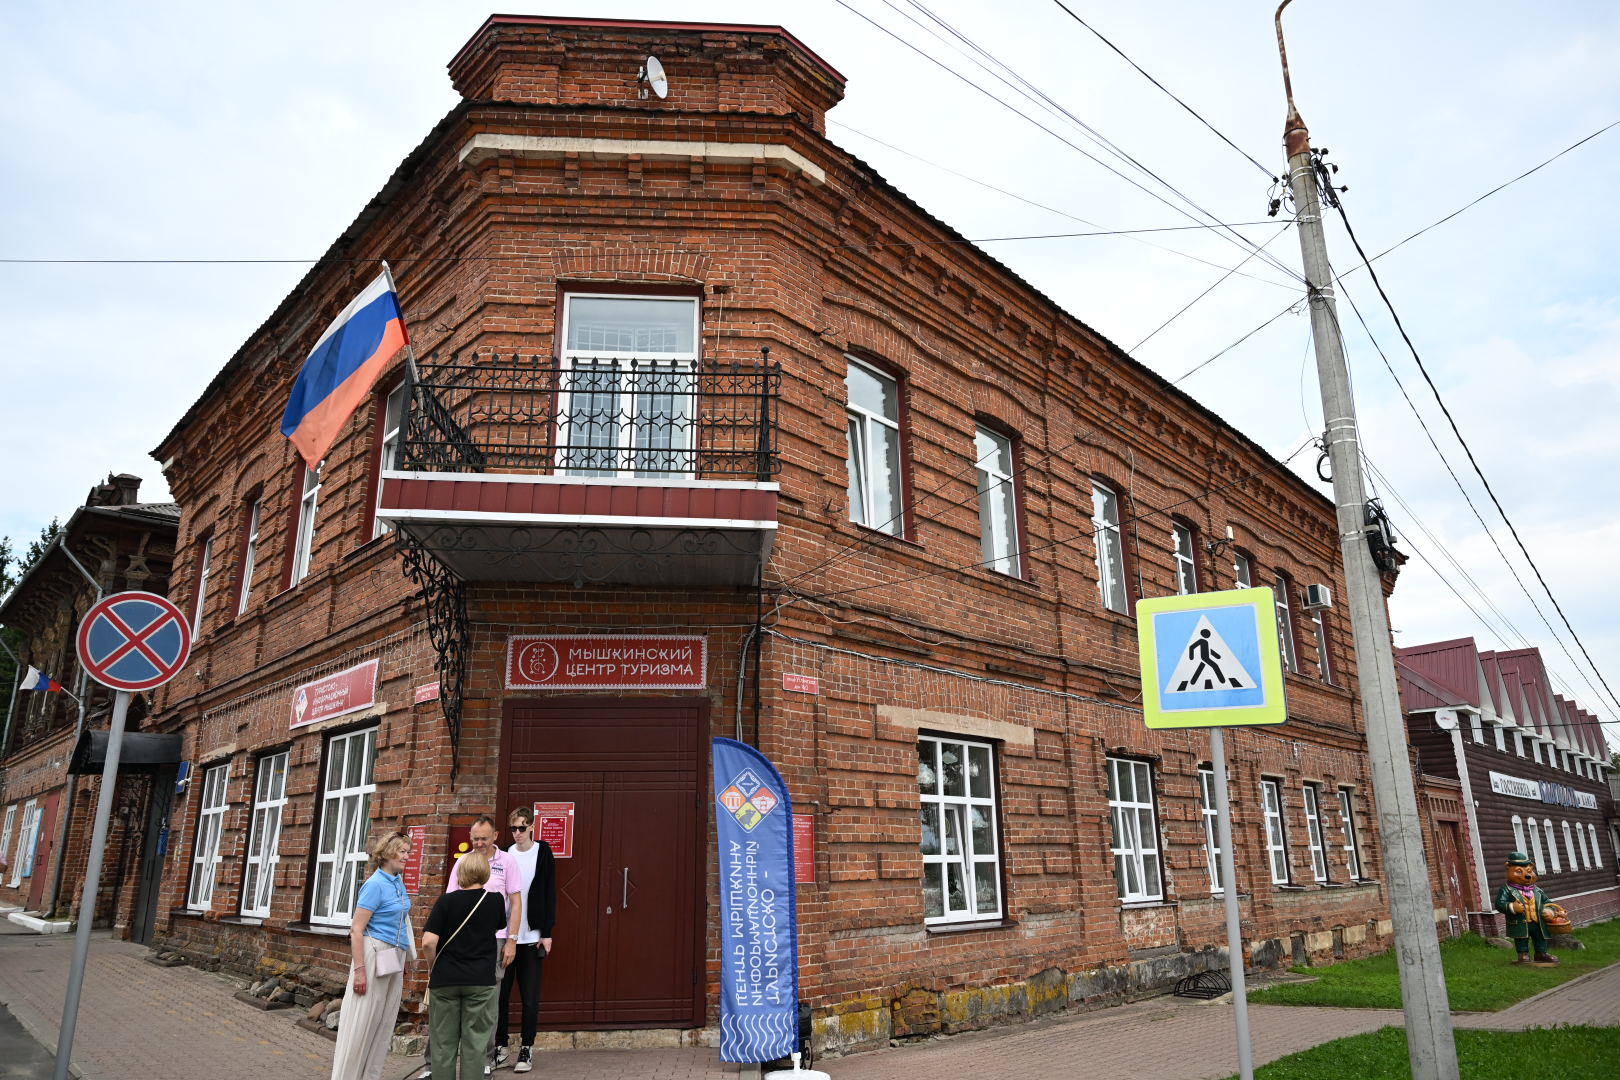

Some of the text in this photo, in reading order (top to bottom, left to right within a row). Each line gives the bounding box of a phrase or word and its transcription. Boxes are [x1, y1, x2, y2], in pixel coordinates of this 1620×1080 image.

[568, 646, 693, 660] МЫШКИНСКИЙ
[566, 663, 694, 677] ЦЕНТР ТУРИЗМА
